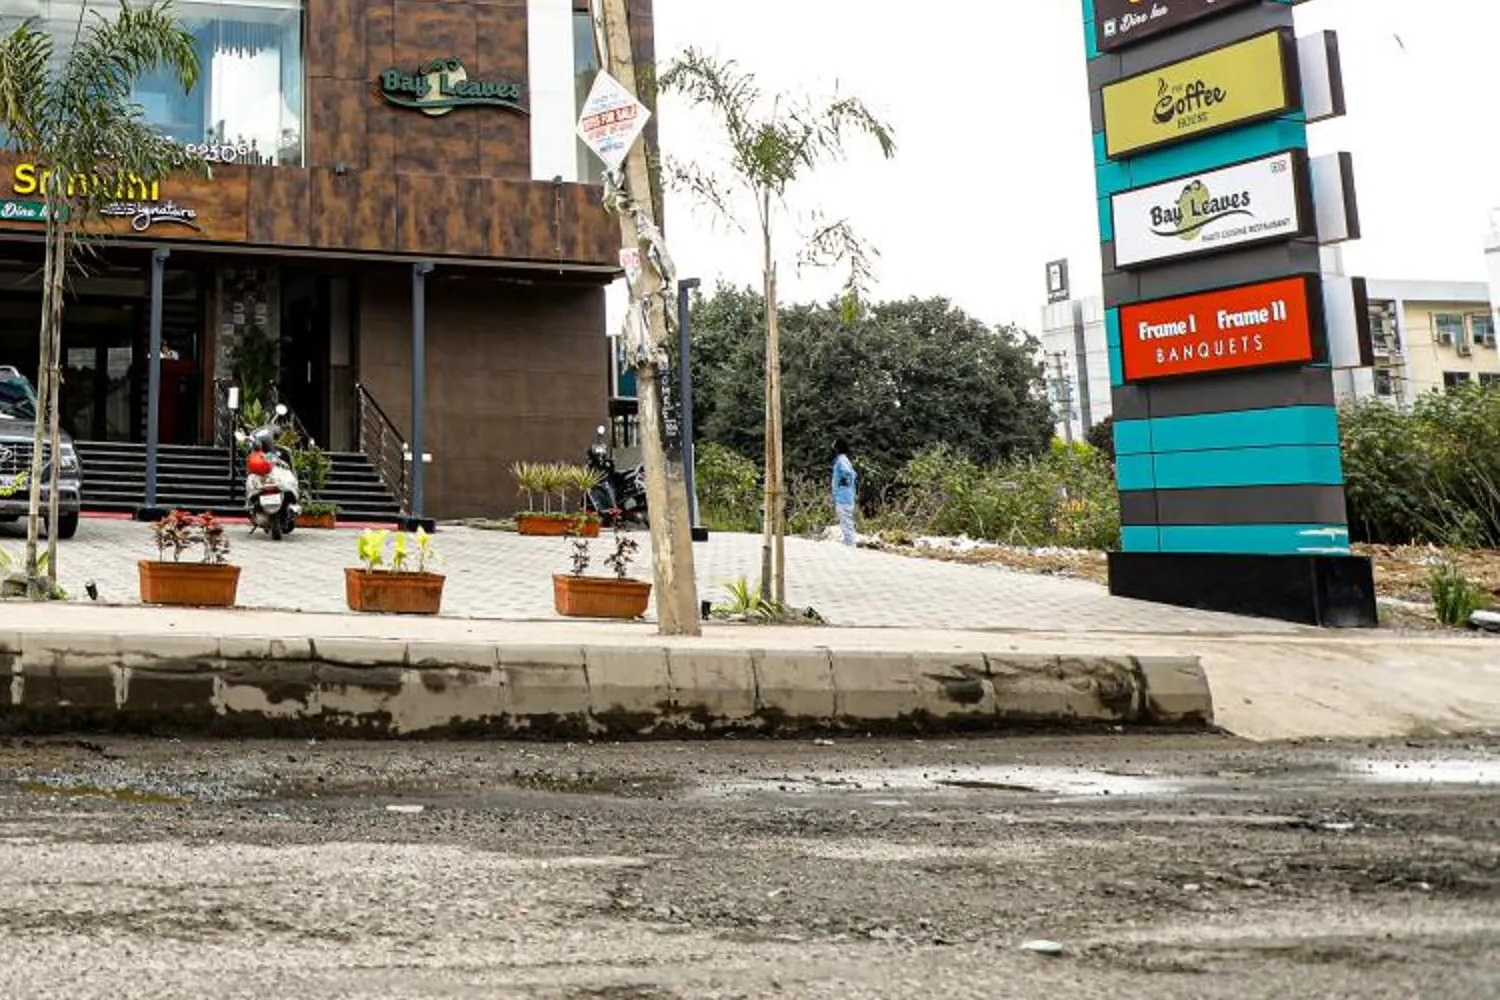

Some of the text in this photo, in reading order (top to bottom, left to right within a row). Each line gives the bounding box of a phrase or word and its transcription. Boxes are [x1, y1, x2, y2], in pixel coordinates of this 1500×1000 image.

[382, 68, 520, 97] Bay Leaves
[1153, 79, 1227, 124] Coffee
[14, 163, 159, 201] Srnhi
[0, 202, 36, 218] Dine
[1150, 191, 1252, 227] Bay Leaves
[1139, 320, 1187, 340] Frame
[1217, 308, 1269, 329] Frame
[1156, 334, 1263, 363] BANQUETS
